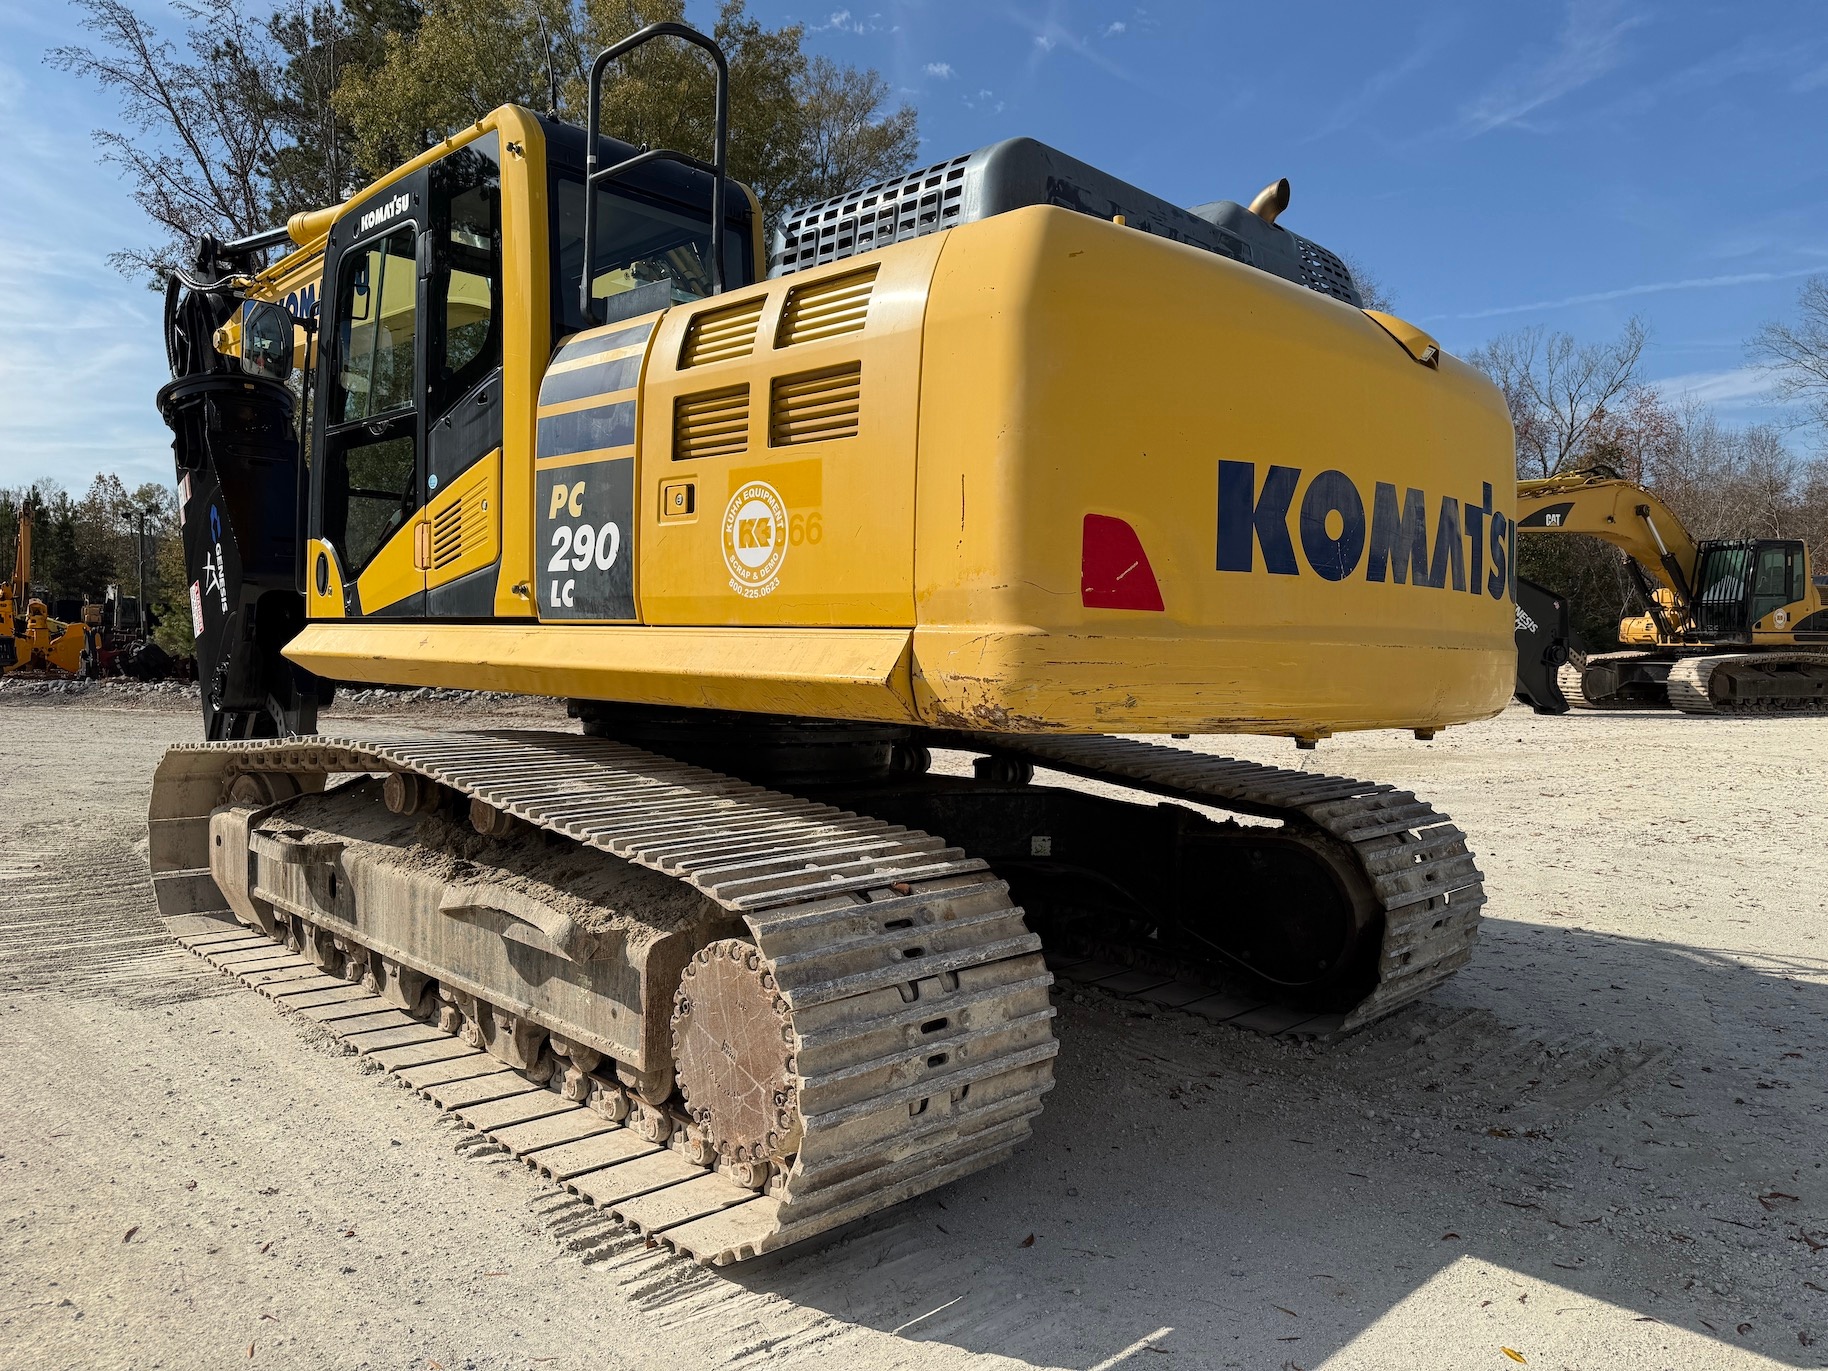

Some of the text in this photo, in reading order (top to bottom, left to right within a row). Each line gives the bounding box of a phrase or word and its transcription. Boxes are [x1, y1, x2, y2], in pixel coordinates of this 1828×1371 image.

[361, 193, 410, 232] KOMATSU
[549, 481, 586, 520] PC
[726, 487, 784, 533] KUHN EQUIPMENT
[1545, 513, 1561, 527] CAT
[547, 521, 620, 572] 290
[215, 542, 230, 614] GENESIS
[729, 552, 779, 581] SCRAP & DEMO
[550, 579, 576, 608] LC
[728, 577, 781, 599] 800.225.0623
